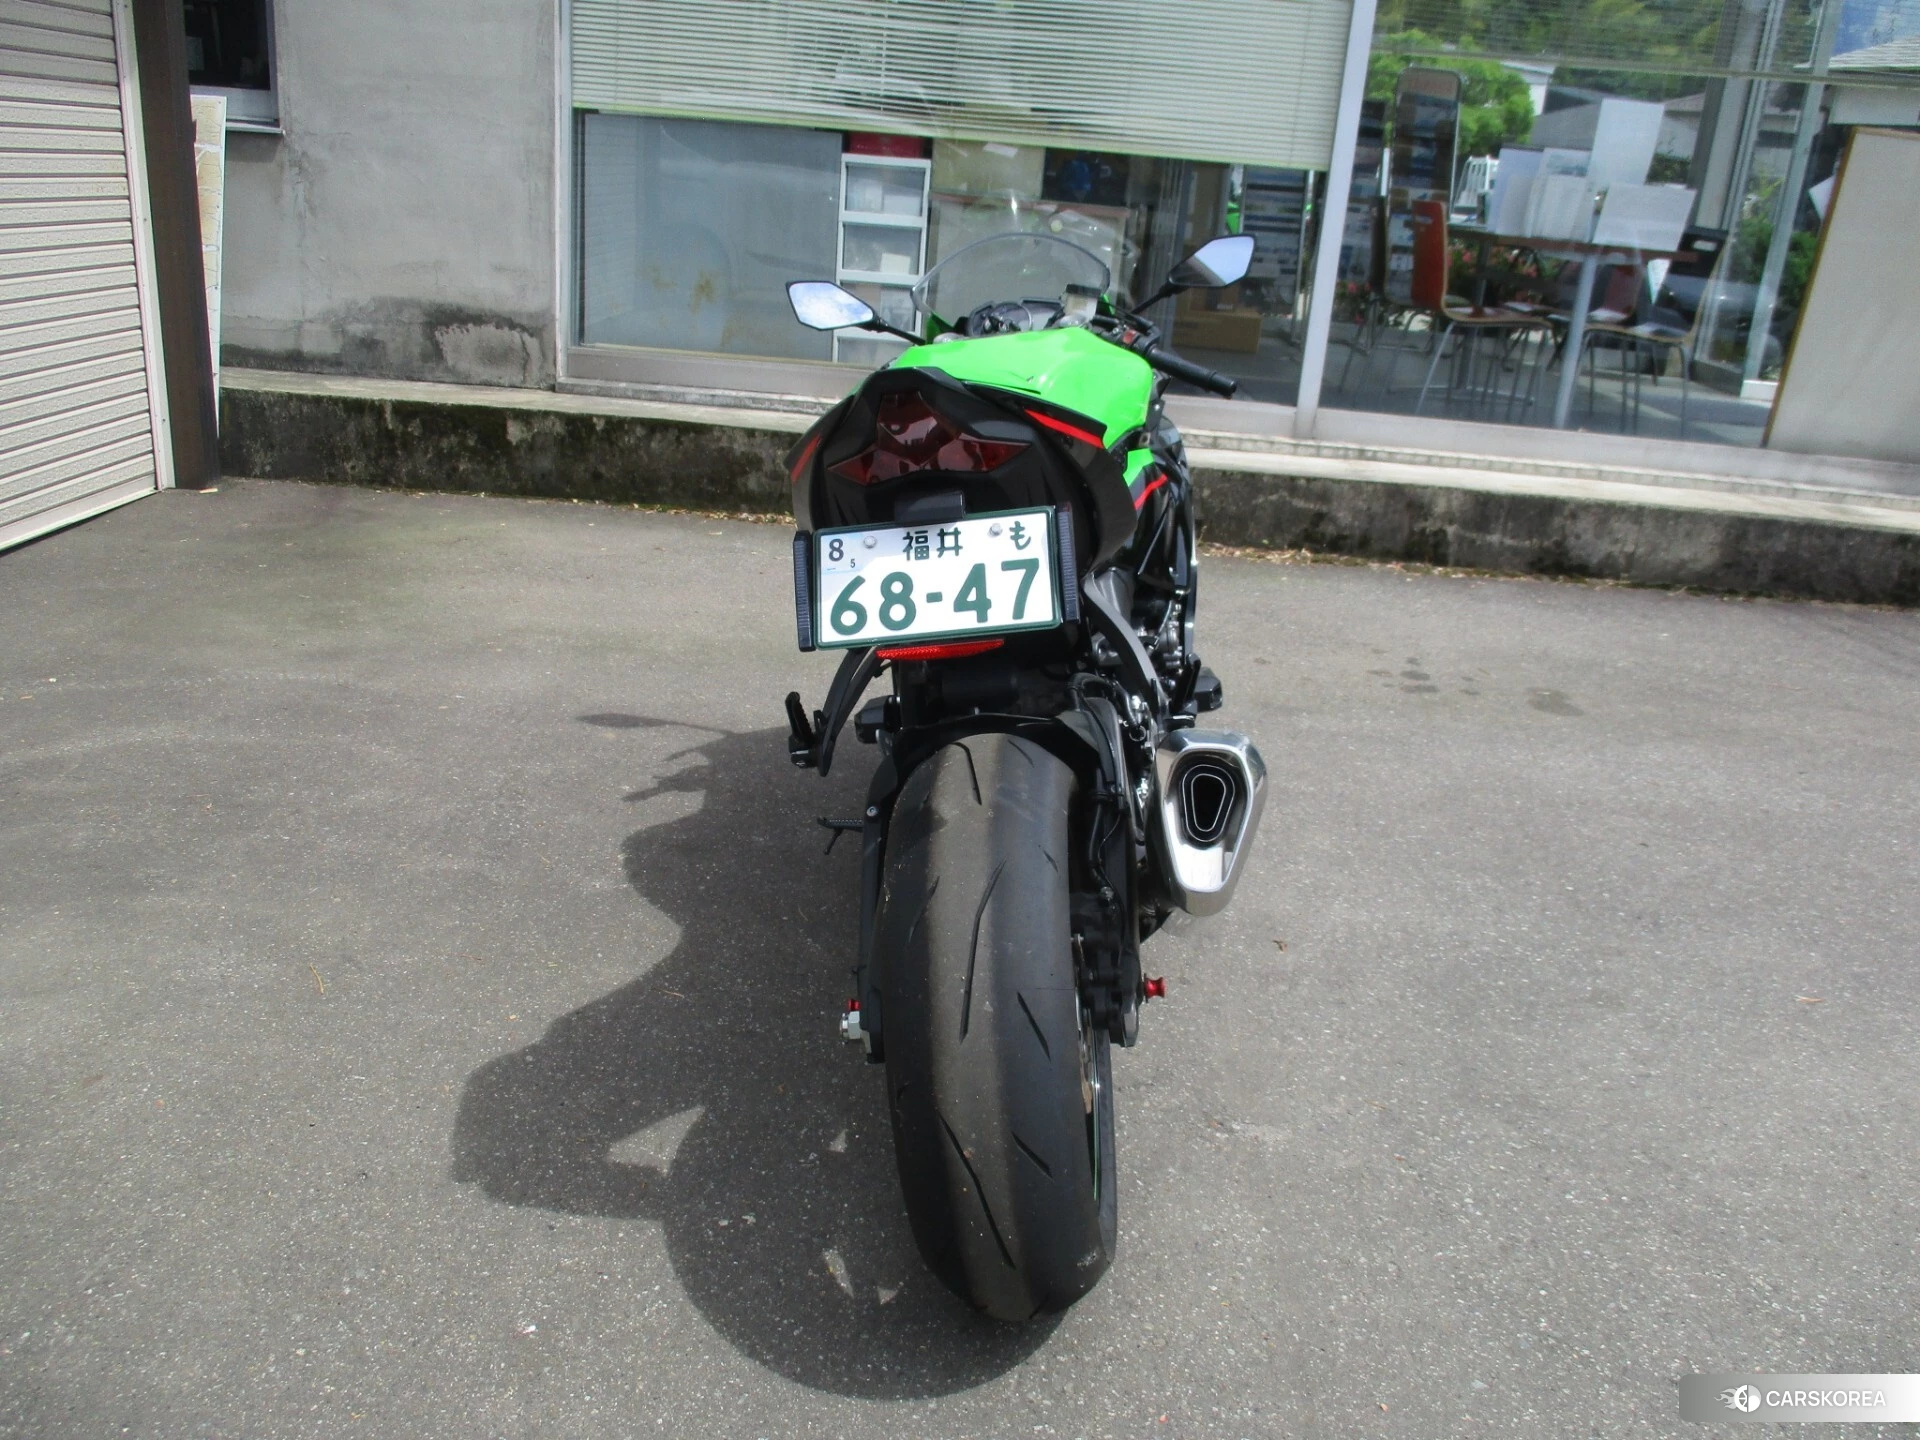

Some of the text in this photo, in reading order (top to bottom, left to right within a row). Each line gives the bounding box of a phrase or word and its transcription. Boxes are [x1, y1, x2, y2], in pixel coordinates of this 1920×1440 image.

[829, 538, 844, 562] 8
[902, 521, 1031, 561] 福井 も
[850, 558, 856, 569] 5
[830, 558, 1039, 636] 68-47
